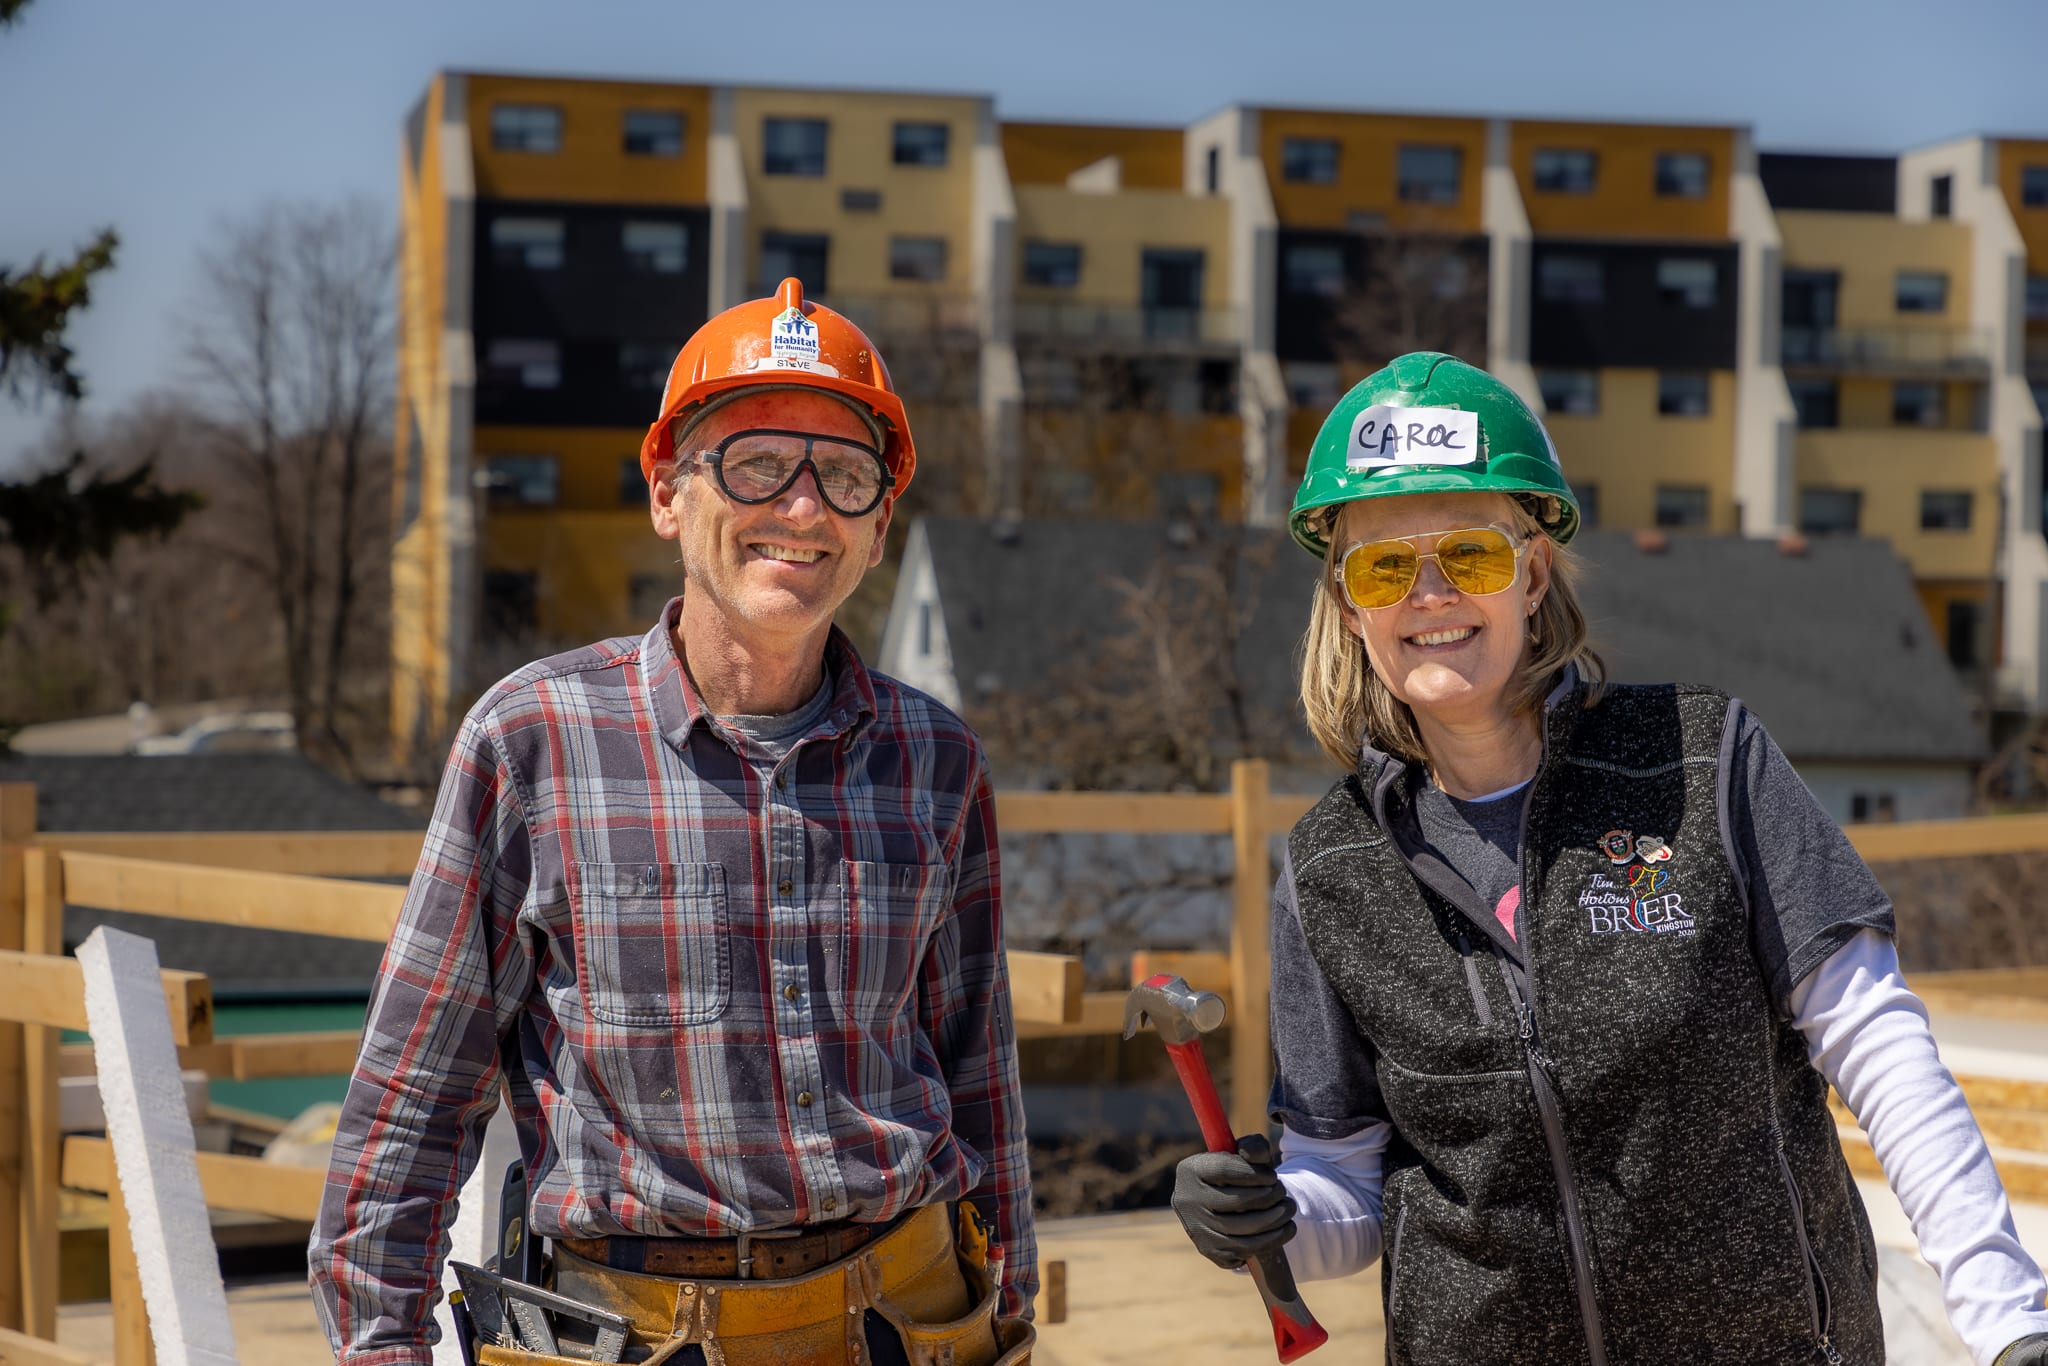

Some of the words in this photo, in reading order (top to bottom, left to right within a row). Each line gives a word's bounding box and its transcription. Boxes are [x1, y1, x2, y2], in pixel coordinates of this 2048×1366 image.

[774, 336, 817, 348] Habitat
[785, 345, 817, 354] Humanity
[1589, 873, 1614, 888] Tim
[1578, 889, 1630, 908] Hortons
[1656, 919, 1695, 934] KINGSTON
[1677, 929, 1696, 937] 2020
